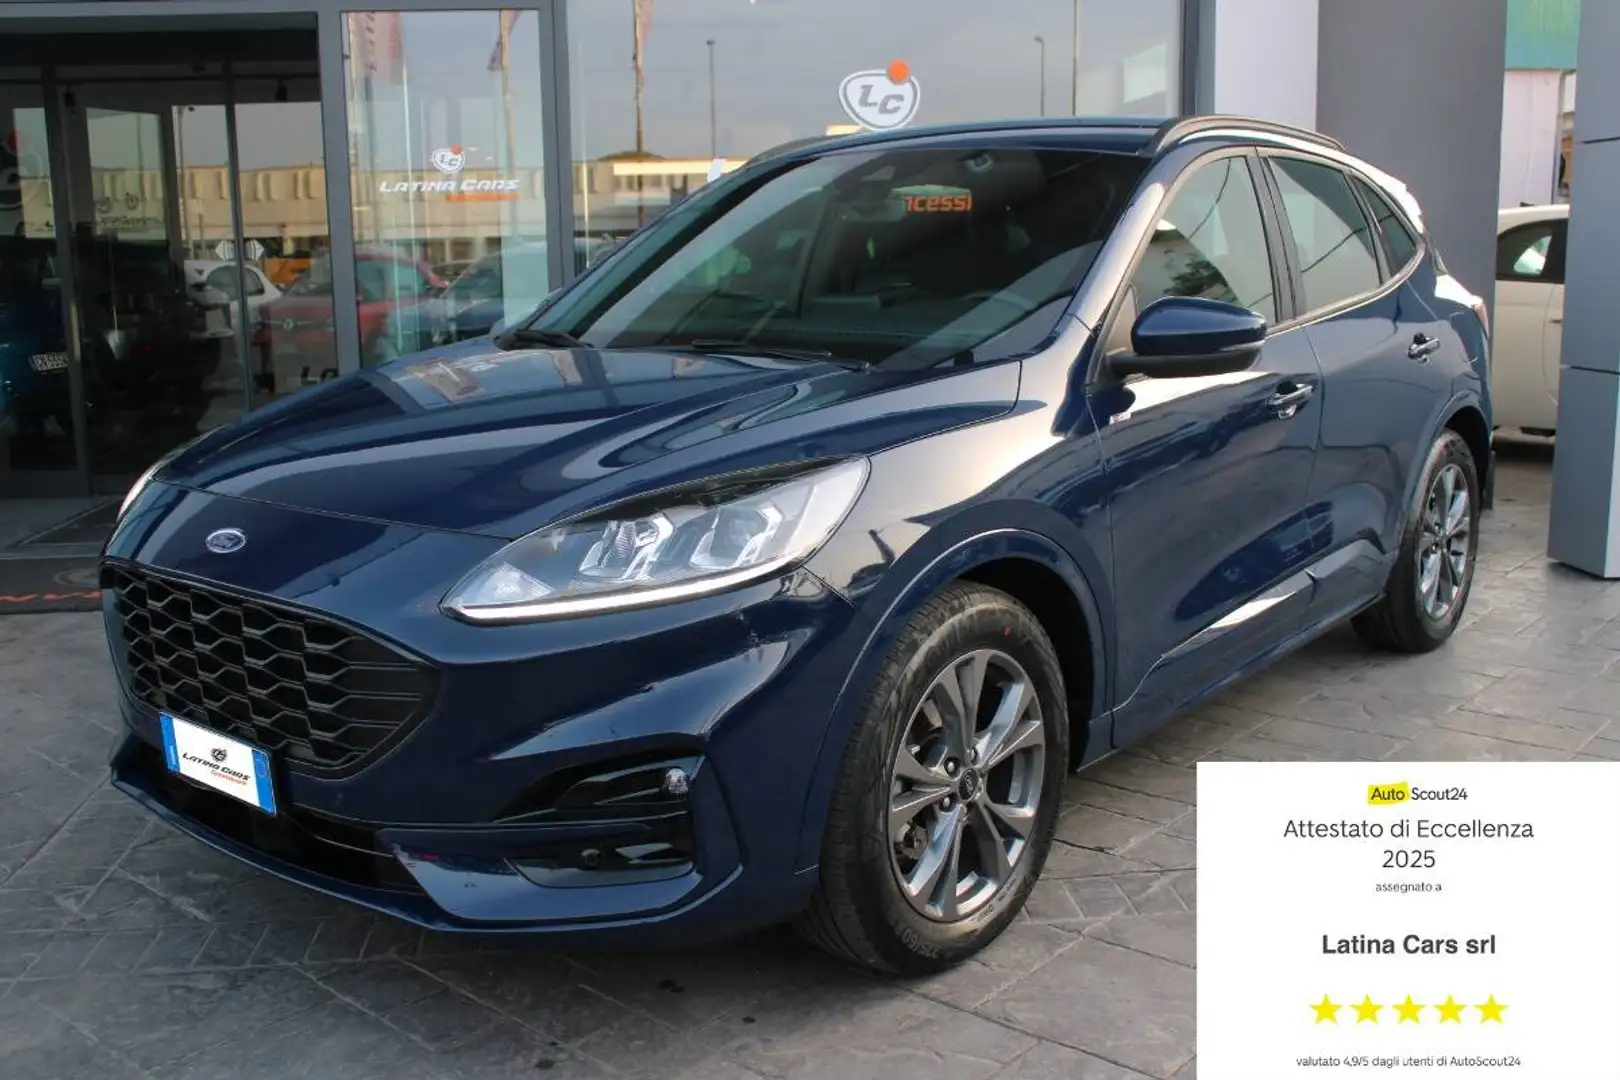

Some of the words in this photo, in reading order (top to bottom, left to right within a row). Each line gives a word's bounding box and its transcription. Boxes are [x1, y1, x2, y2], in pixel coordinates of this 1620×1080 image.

[858, 84, 905, 115] LC
[379, 179, 454, 193] LATINA
[460, 178, 520, 191] CARS
